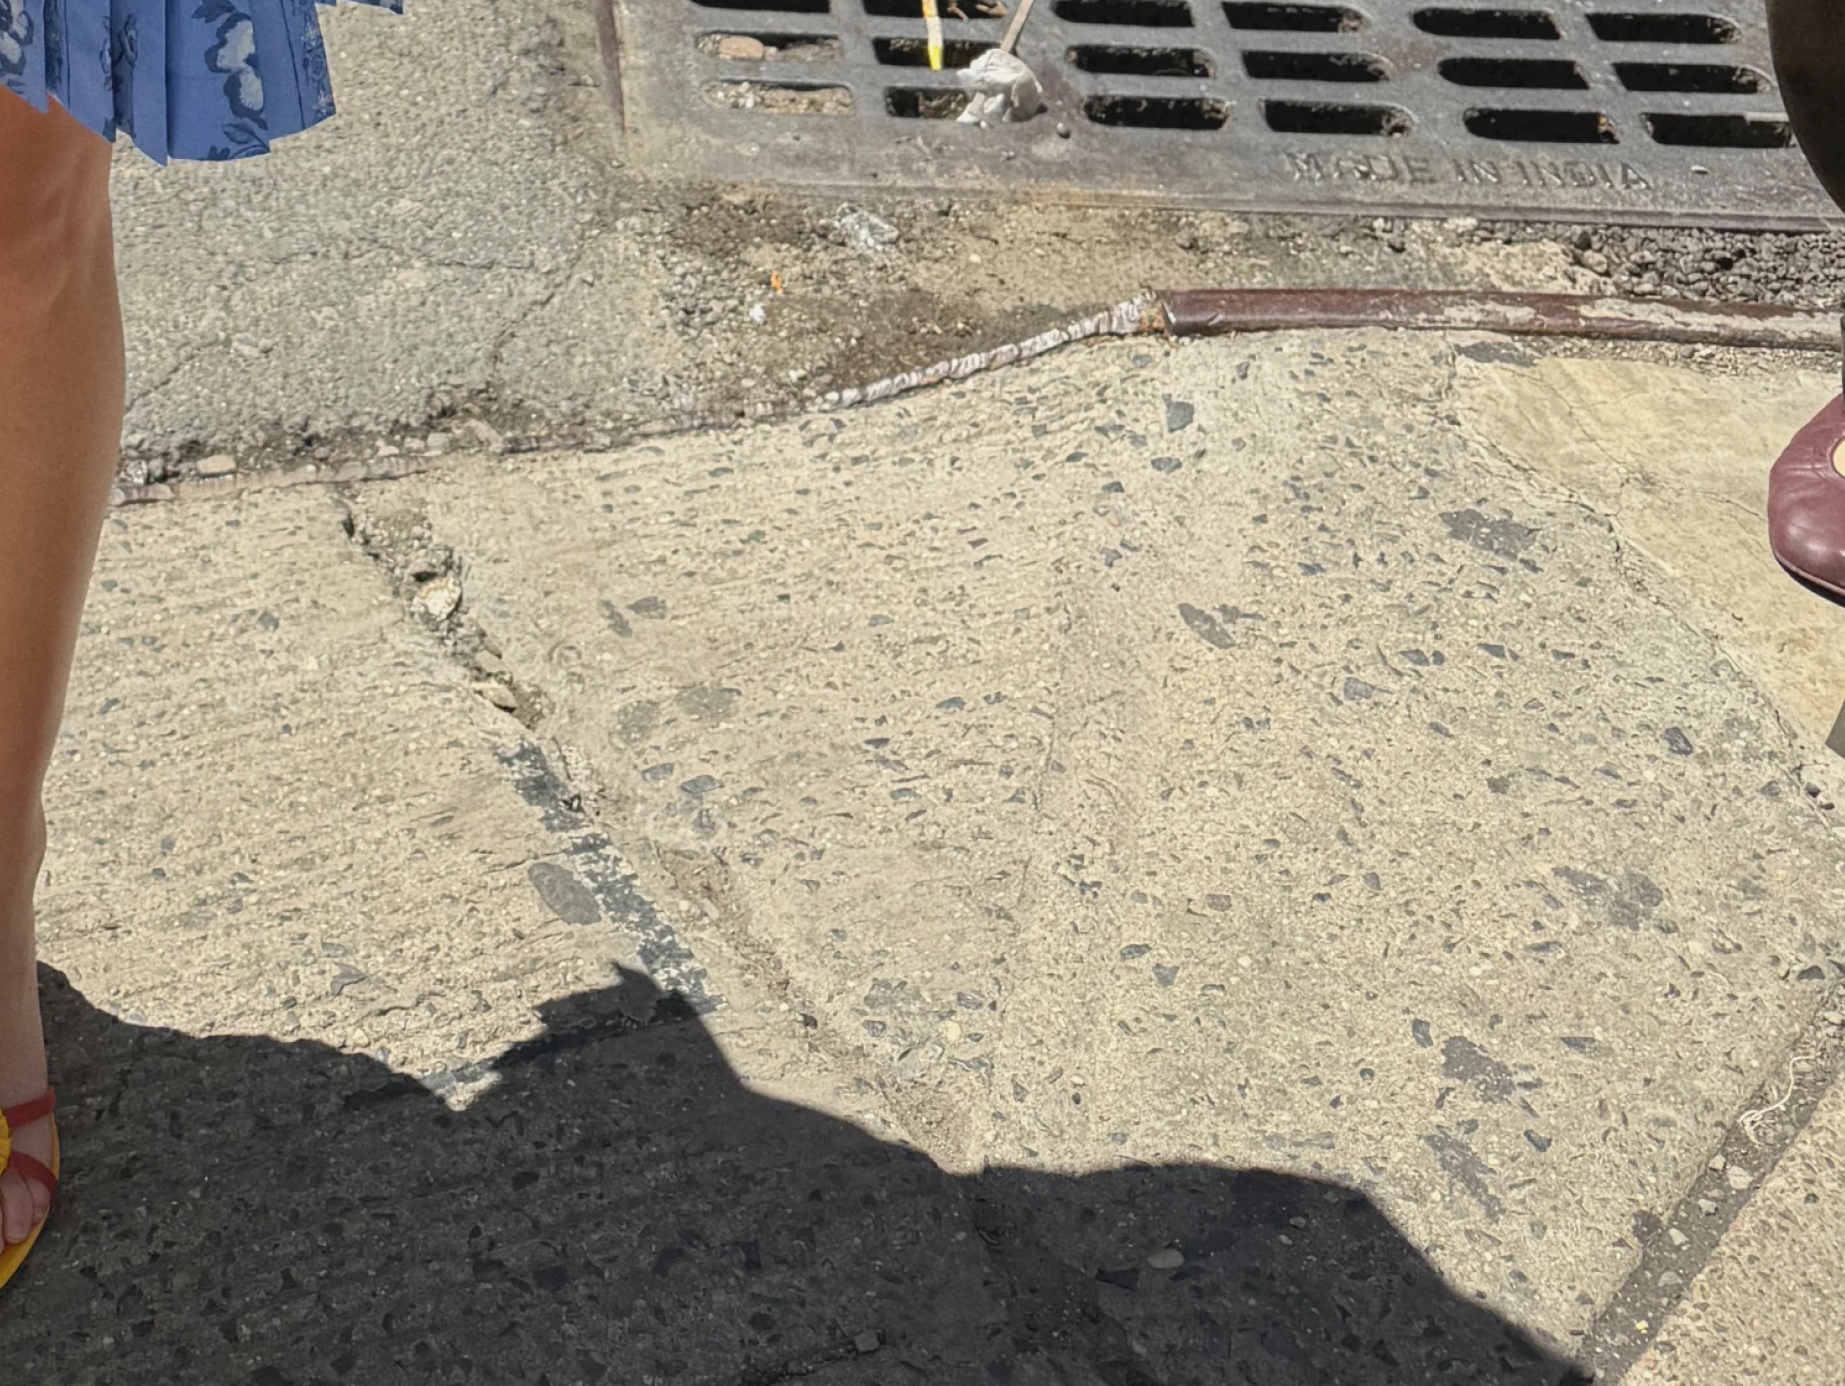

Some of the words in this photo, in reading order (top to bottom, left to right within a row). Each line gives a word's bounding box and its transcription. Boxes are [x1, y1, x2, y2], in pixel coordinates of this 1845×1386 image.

[1284, 151, 1438, 185] MADE
[1453, 157, 1503, 185] IN
[1512, 159, 1654, 191] INDIA
